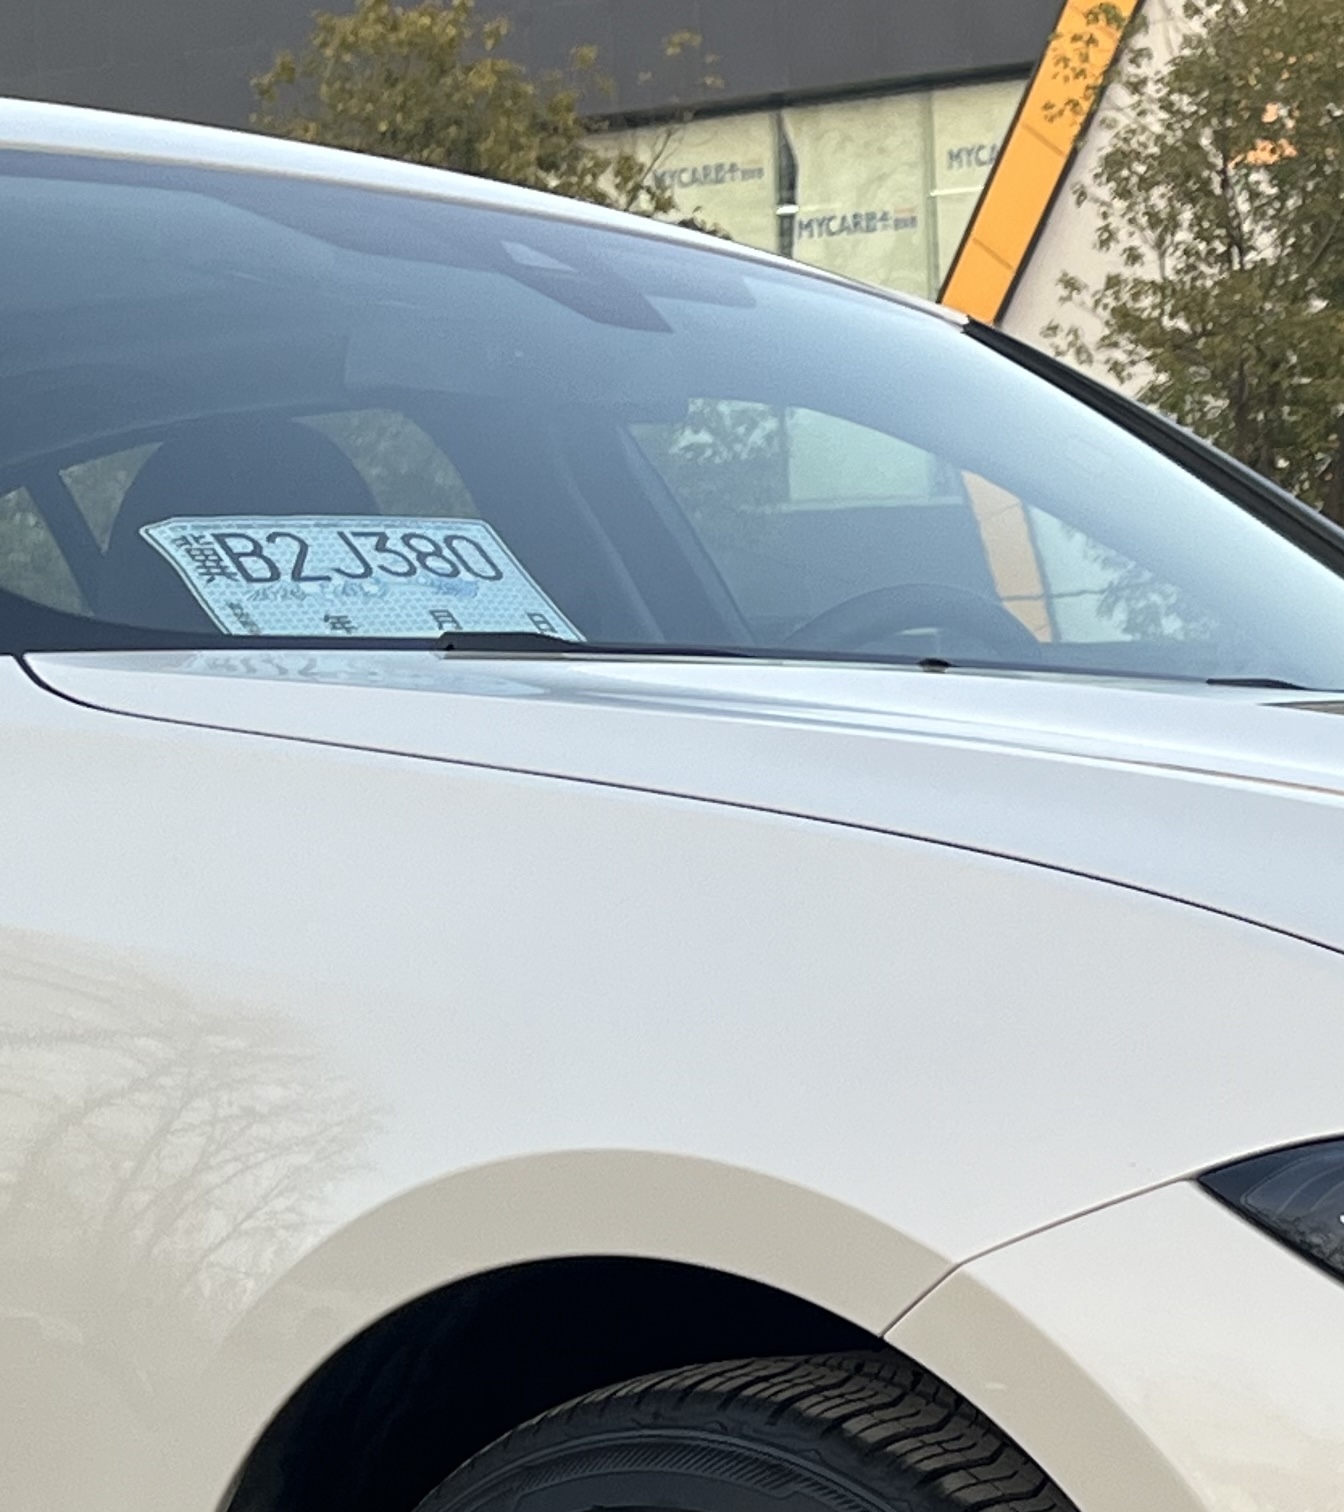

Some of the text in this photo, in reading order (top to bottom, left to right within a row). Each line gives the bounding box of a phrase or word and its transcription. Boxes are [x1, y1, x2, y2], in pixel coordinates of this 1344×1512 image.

[171, 531, 504, 584] 冀B2J380
[324, 611, 358, 634] 年
[430, 609, 463, 631] 月
